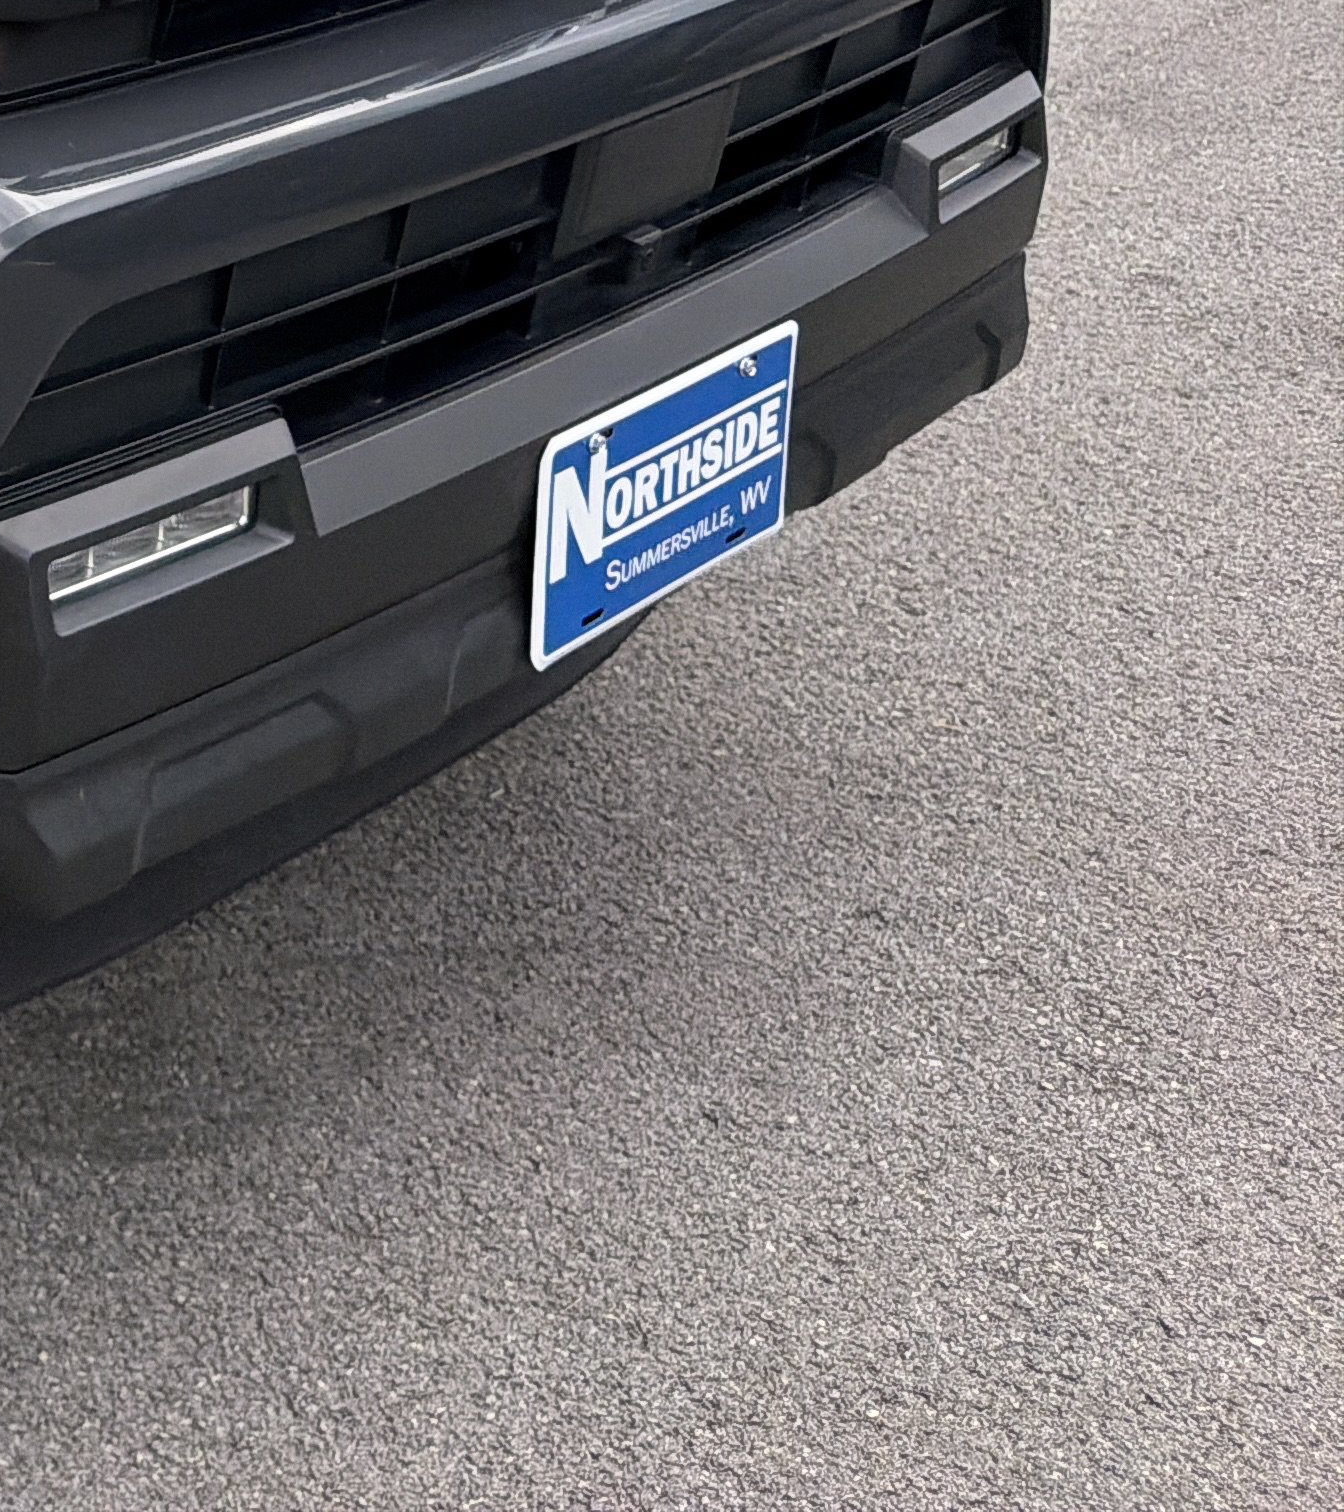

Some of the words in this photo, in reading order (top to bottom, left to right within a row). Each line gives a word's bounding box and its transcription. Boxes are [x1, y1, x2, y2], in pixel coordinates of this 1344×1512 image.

[549, 396, 782, 585] NORTHSIDE
[604, 503, 735, 592] SUMMERSVILLE,
[739, 474, 773, 516] WV
